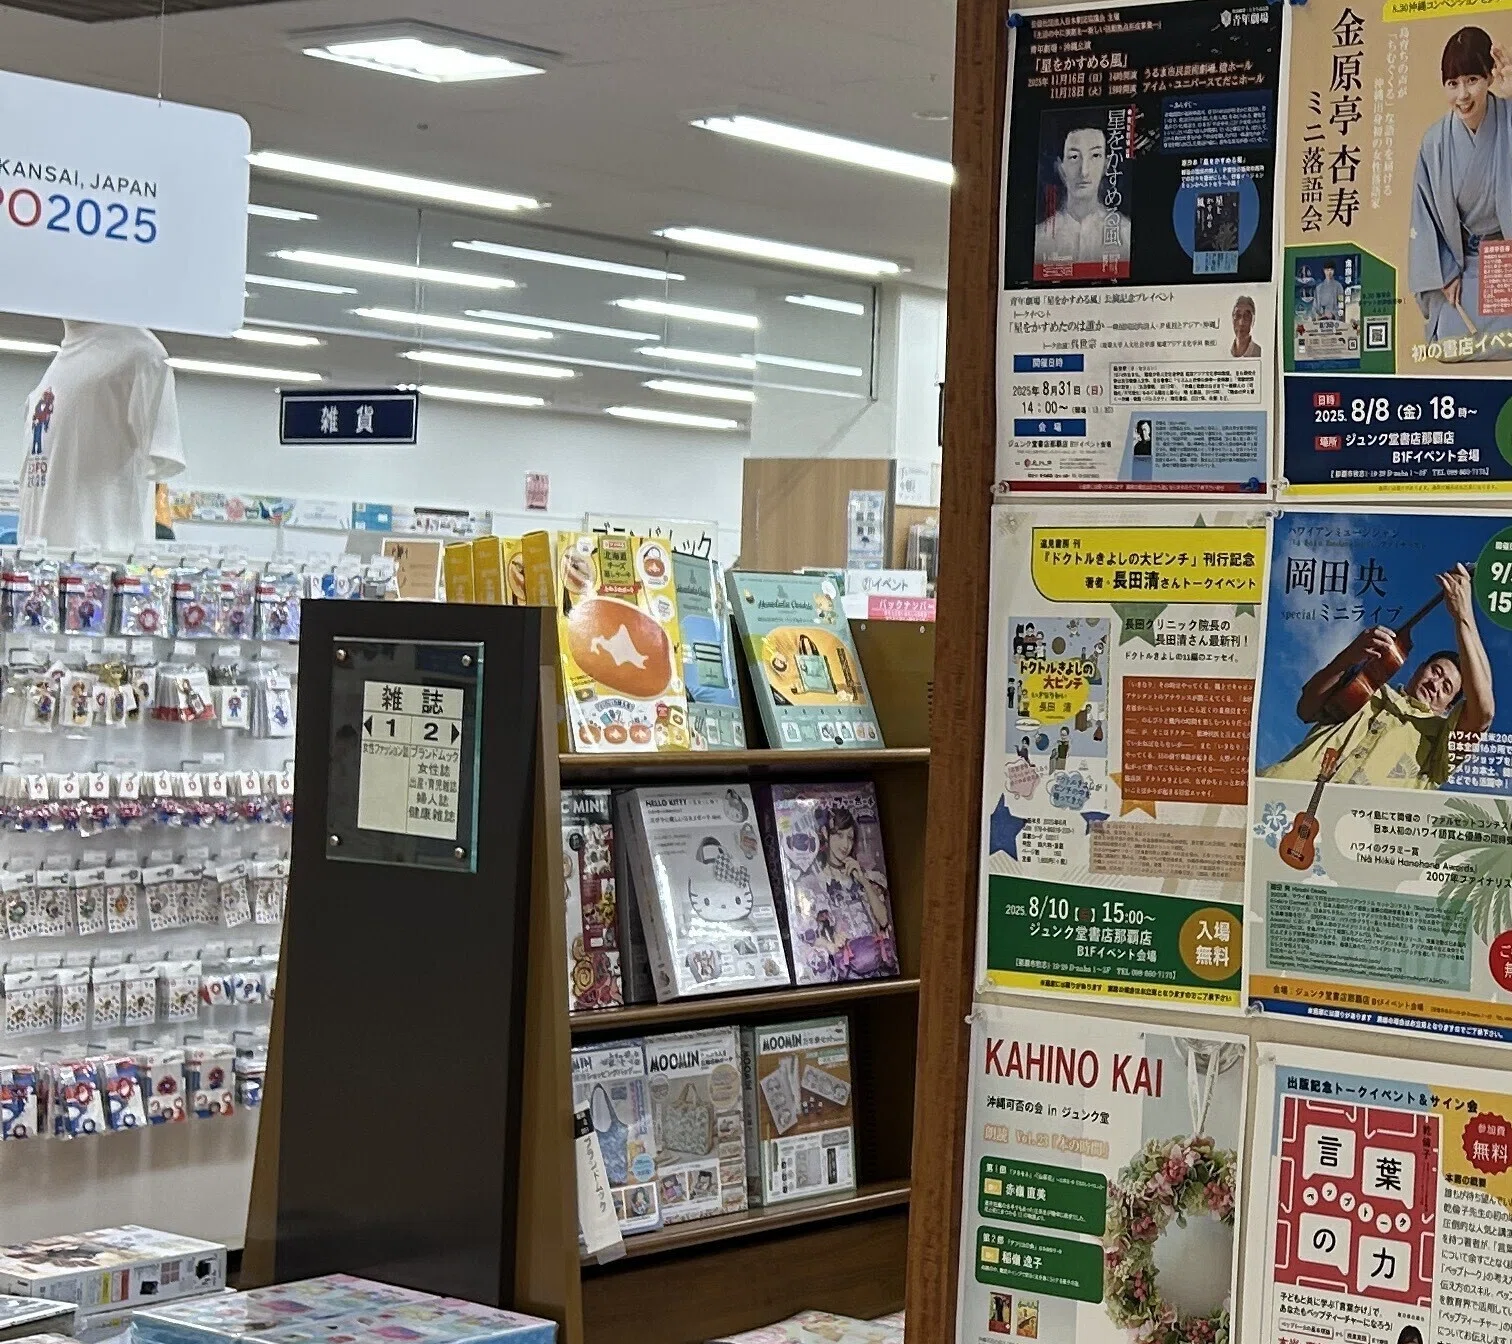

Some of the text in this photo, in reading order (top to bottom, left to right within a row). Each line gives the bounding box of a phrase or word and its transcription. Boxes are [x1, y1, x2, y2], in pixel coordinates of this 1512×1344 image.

[1327, 8, 1365, 228] 金原亭杏寿
[1301, 91, 1326, 233] ミニ落語会
[91, 172, 157, 199] JAPAN
[320, 404, 374, 435] 雑貨
[1315, 397, 1390, 425] 2025. 8/8
[1346, 431, 1455, 446] ジュンク堂書店那覇店
[1392, 449, 1480, 464] B1Fイベント会場
[1203, 553, 1255, 566] 刊行記念
[1285, 557, 1388, 598] 岡田央
[1320, 605, 1402, 623] ミニライブ
[1125, 619, 1230, 631] 長田クリニック院長の
[1020, 660, 1094, 676] ドクトルきよしの
[1044, 676, 1083, 690] 大ピンチ
[382, 685, 443, 715] 雑誌
[386, 719, 395, 737] 1
[424, 723, 438, 741] 2
[412, 745, 458, 761] ブランドムック
[418, 762, 450, 777] 女性誌
[417, 792, 449, 807] 婦人誌
[409, 807, 455, 822] 健康雑誌
[1005, 905, 1026, 916] 2025.
[1029, 896, 1069, 920] 8/10
[1029, 923, 1152, 945] ジュンク堂書店那覇店
[1197, 920, 1229, 942] 入場
[1077, 945, 1157, 962] B1Fイベント会場
[1195, 946, 1229, 966] 無料
[763, 1035, 801, 1051] MOOMIN
[650, 1051, 699, 1072] MOOMIN
[985, 1038, 1163, 1098] KAHINO KAI
[987, 1095, 1109, 1124] 沖縄可否の会 ジュンク堂
[1473, 1140, 1508, 1163] 無料
